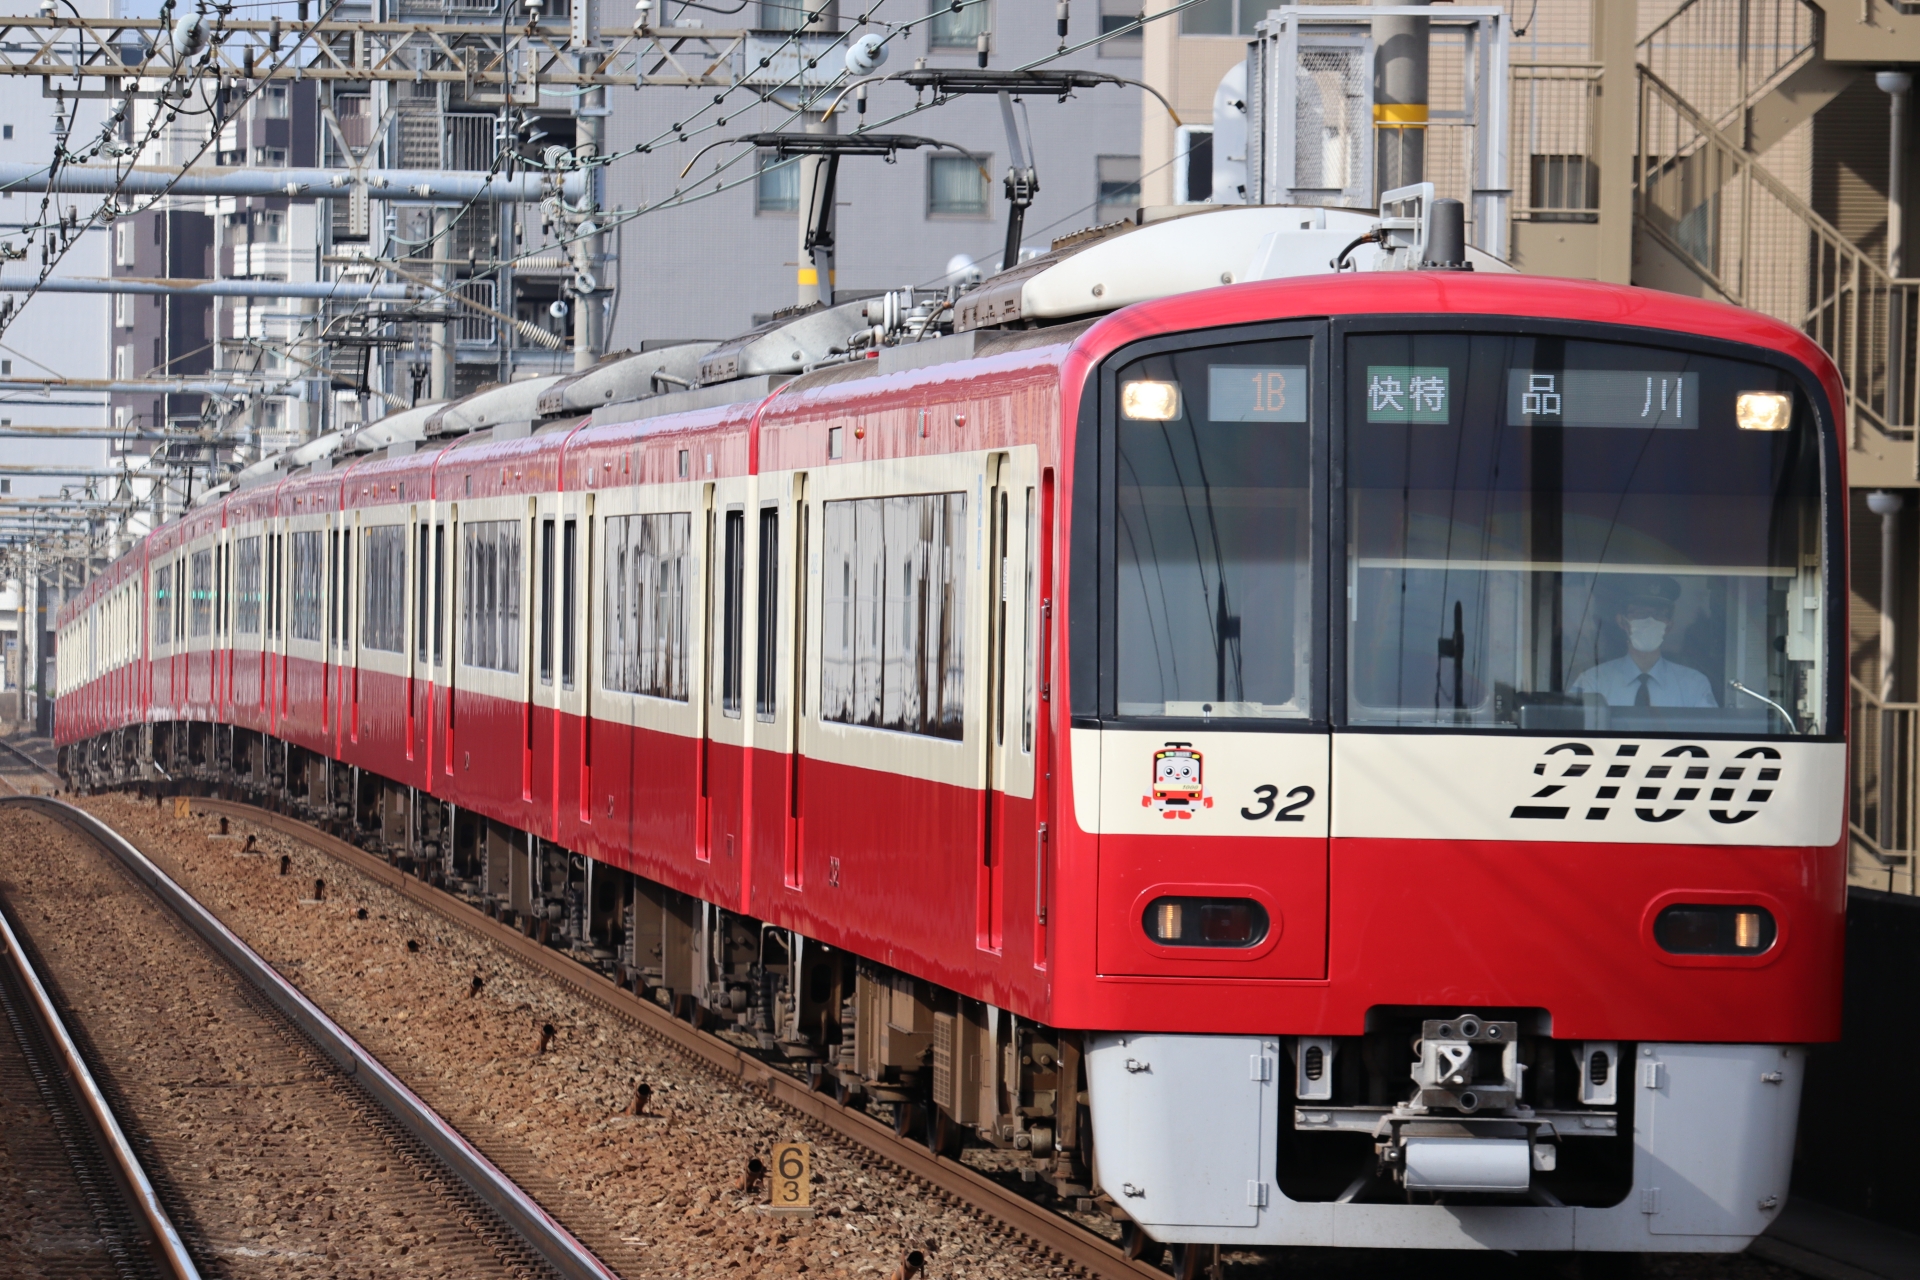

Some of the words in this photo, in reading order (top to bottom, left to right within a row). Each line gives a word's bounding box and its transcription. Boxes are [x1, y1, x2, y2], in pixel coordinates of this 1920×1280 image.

[1252, 372, 1286, 411] 1B
[1368, 375, 1446, 411] 快特
[1522, 374, 1682, 418] 品川
[1509, 742, 1782, 824] 2100
[1240, 784, 1316, 822] 32
[778, 1147, 804, 1180] 6
[782, 1181, 800, 1202] 3
